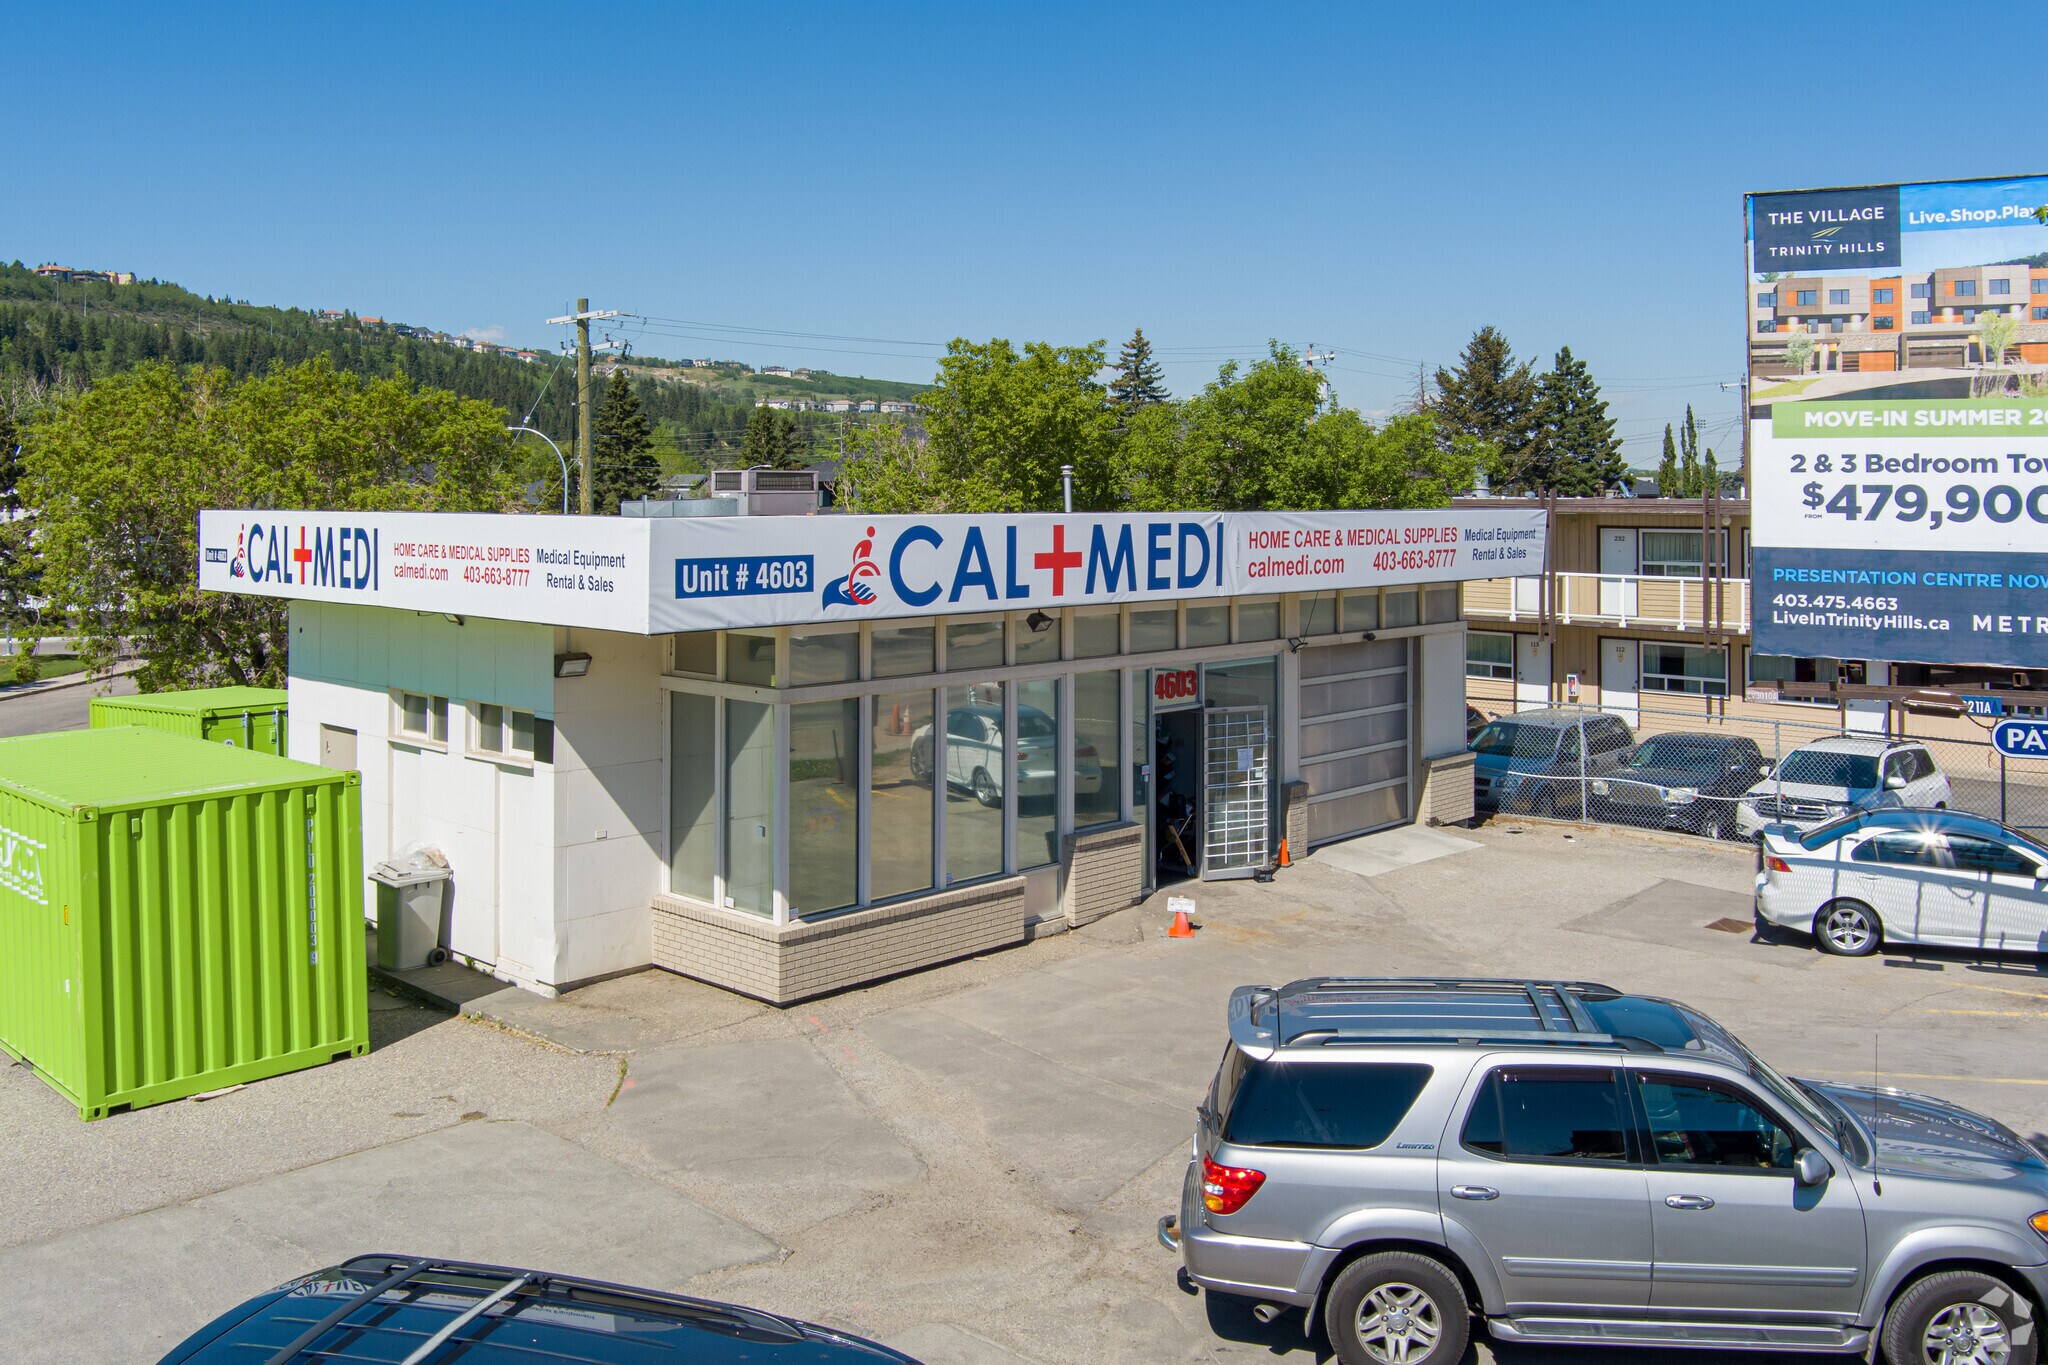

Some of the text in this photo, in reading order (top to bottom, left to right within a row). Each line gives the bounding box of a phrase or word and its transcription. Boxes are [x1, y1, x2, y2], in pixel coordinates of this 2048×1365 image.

[1768, 207, 1884, 225] THE VILLAGE
[1770, 242, 1884, 256] TRINITY HILLS
[1805, 408, 2048, 427] MOVE-IN SUMMER 2
[1791, 453, 2048, 473] 2 & 3 Bedroom To
[1250, 527, 1457, 549] HOME CARE & MEDICAL SUPPLIES
[1465, 528, 1536, 542] Medical Equipment
[248, 524, 378, 591] CAL MEDI
[394, 543, 529, 563] HOME CARE & MEDICAL SUPPLIES
[537, 549, 625, 570] Medical Equipment
[1473, 547, 1526, 560] Rental & Sales
[889, 522, 1224, 606] CAL MEDI
[1248, 549, 1456, 578] calmedi.com 403-663-8777
[394, 563, 529, 586] calmedi.com 403-663-8777
[547, 573, 613, 592] Rental & Sales
[683, 561, 807, 593] Unit # 4603
[1774, 568, 1917, 585] PRESENTATION
[1923, 572, 2003, 588] CENTRE
[1773, 594, 1898, 610] 403.475.4663
[1774, 611, 1949, 630] LiveInTrinityHills.ca
[1154, 669, 1198, 699] 4603
[1965, 700, 1992, 714] 211A
